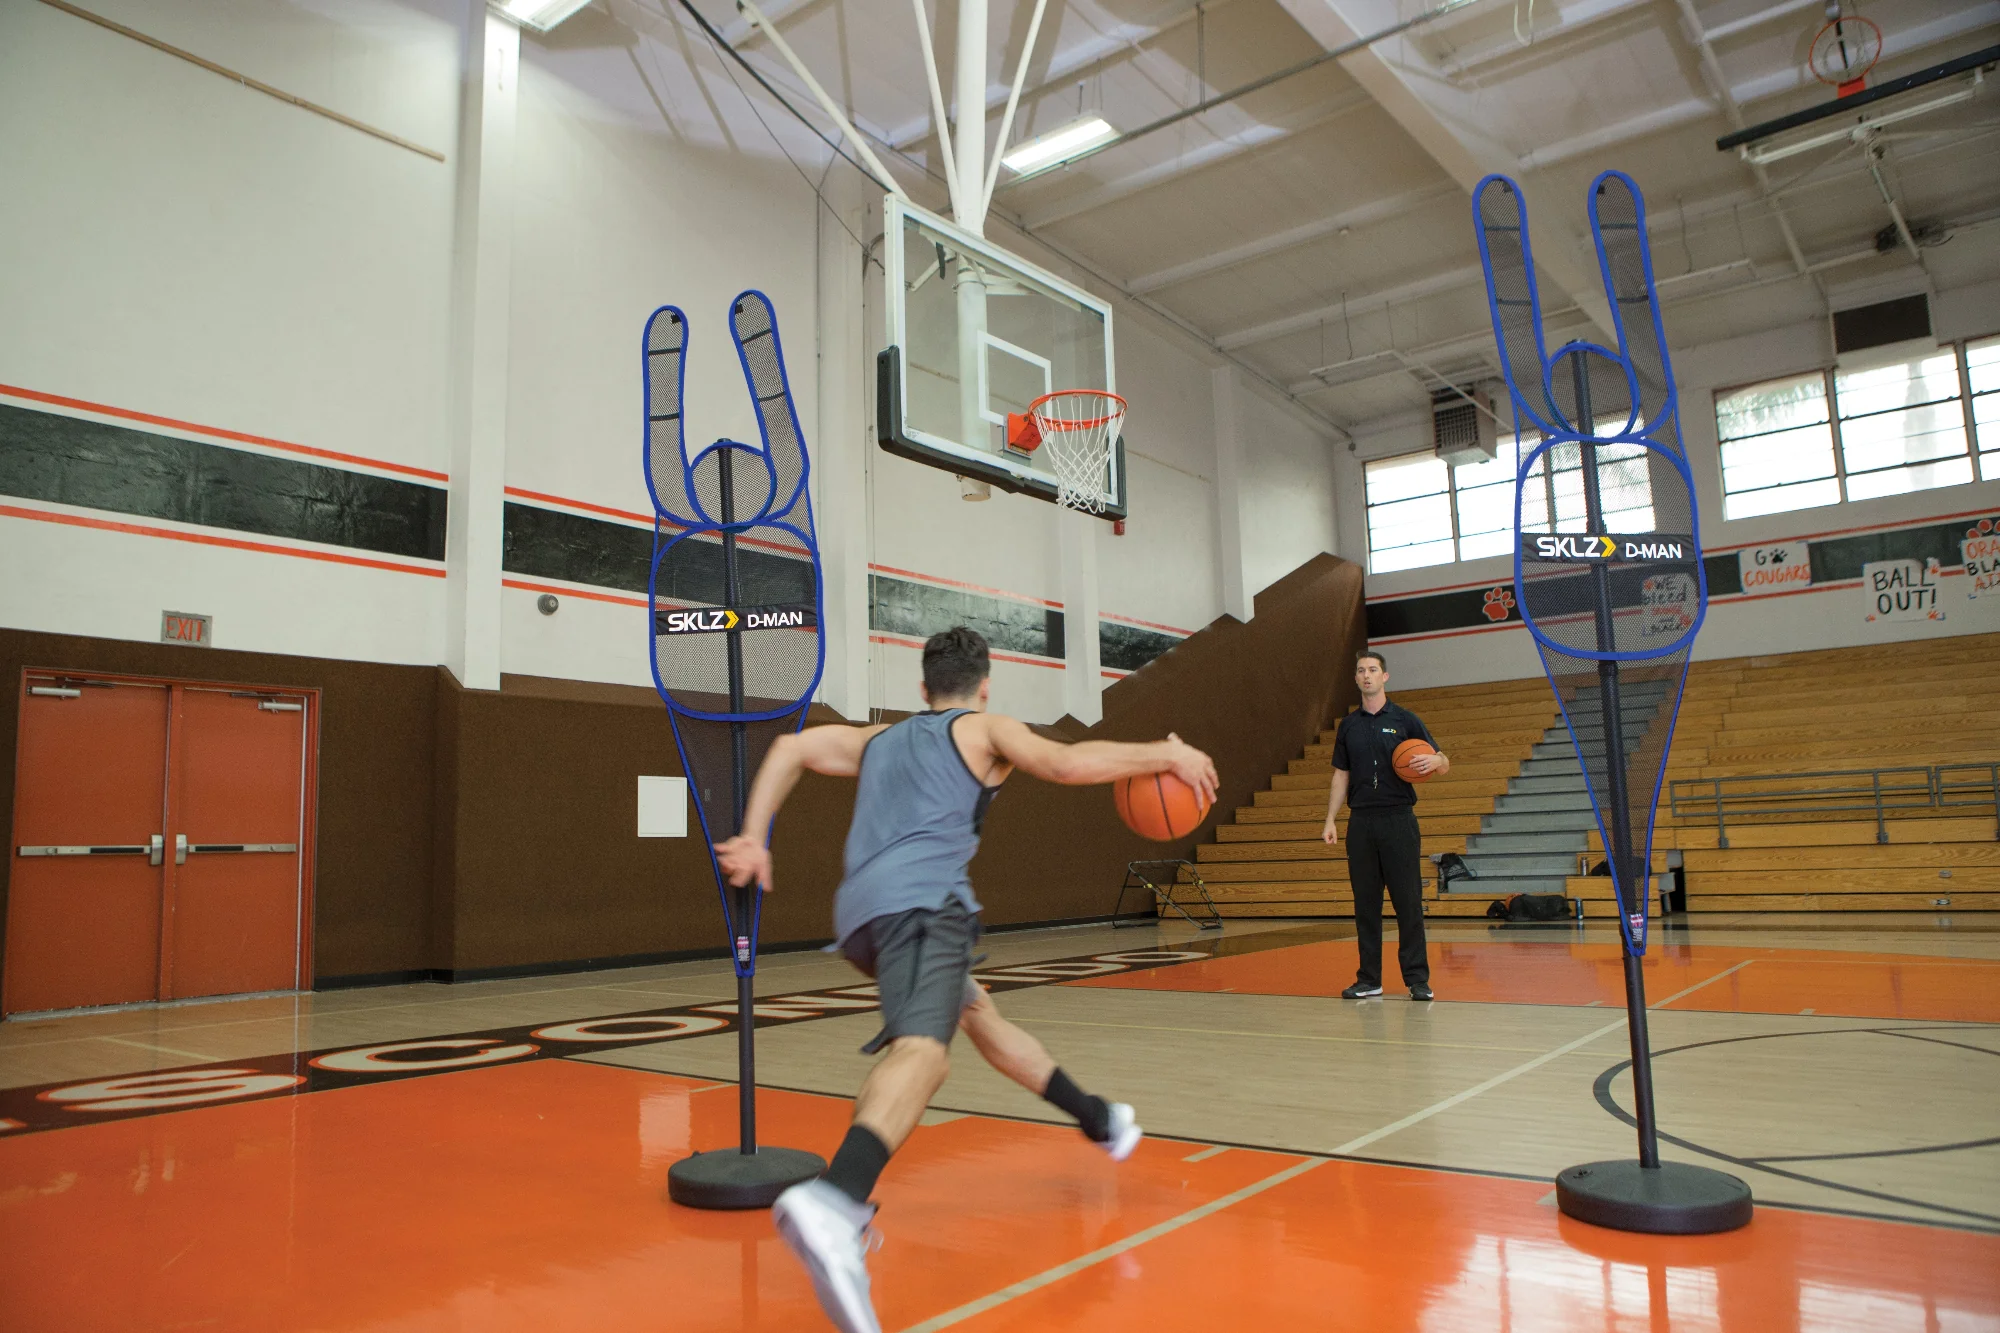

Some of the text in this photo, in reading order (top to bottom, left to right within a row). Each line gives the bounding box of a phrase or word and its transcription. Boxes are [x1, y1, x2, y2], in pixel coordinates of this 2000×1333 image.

[1536, 536, 1682, 559] SKLZ D-MAN
[1743, 563, 1810, 588] COUGARS
[1872, 565, 1935, 592] BALL
[1877, 588, 1936, 615] OUT!
[166, 615, 206, 642] EXIT
[668, 610, 803, 632] SKLZ D-MAN
[0, 951, 1212, 1130] SCONIDO
